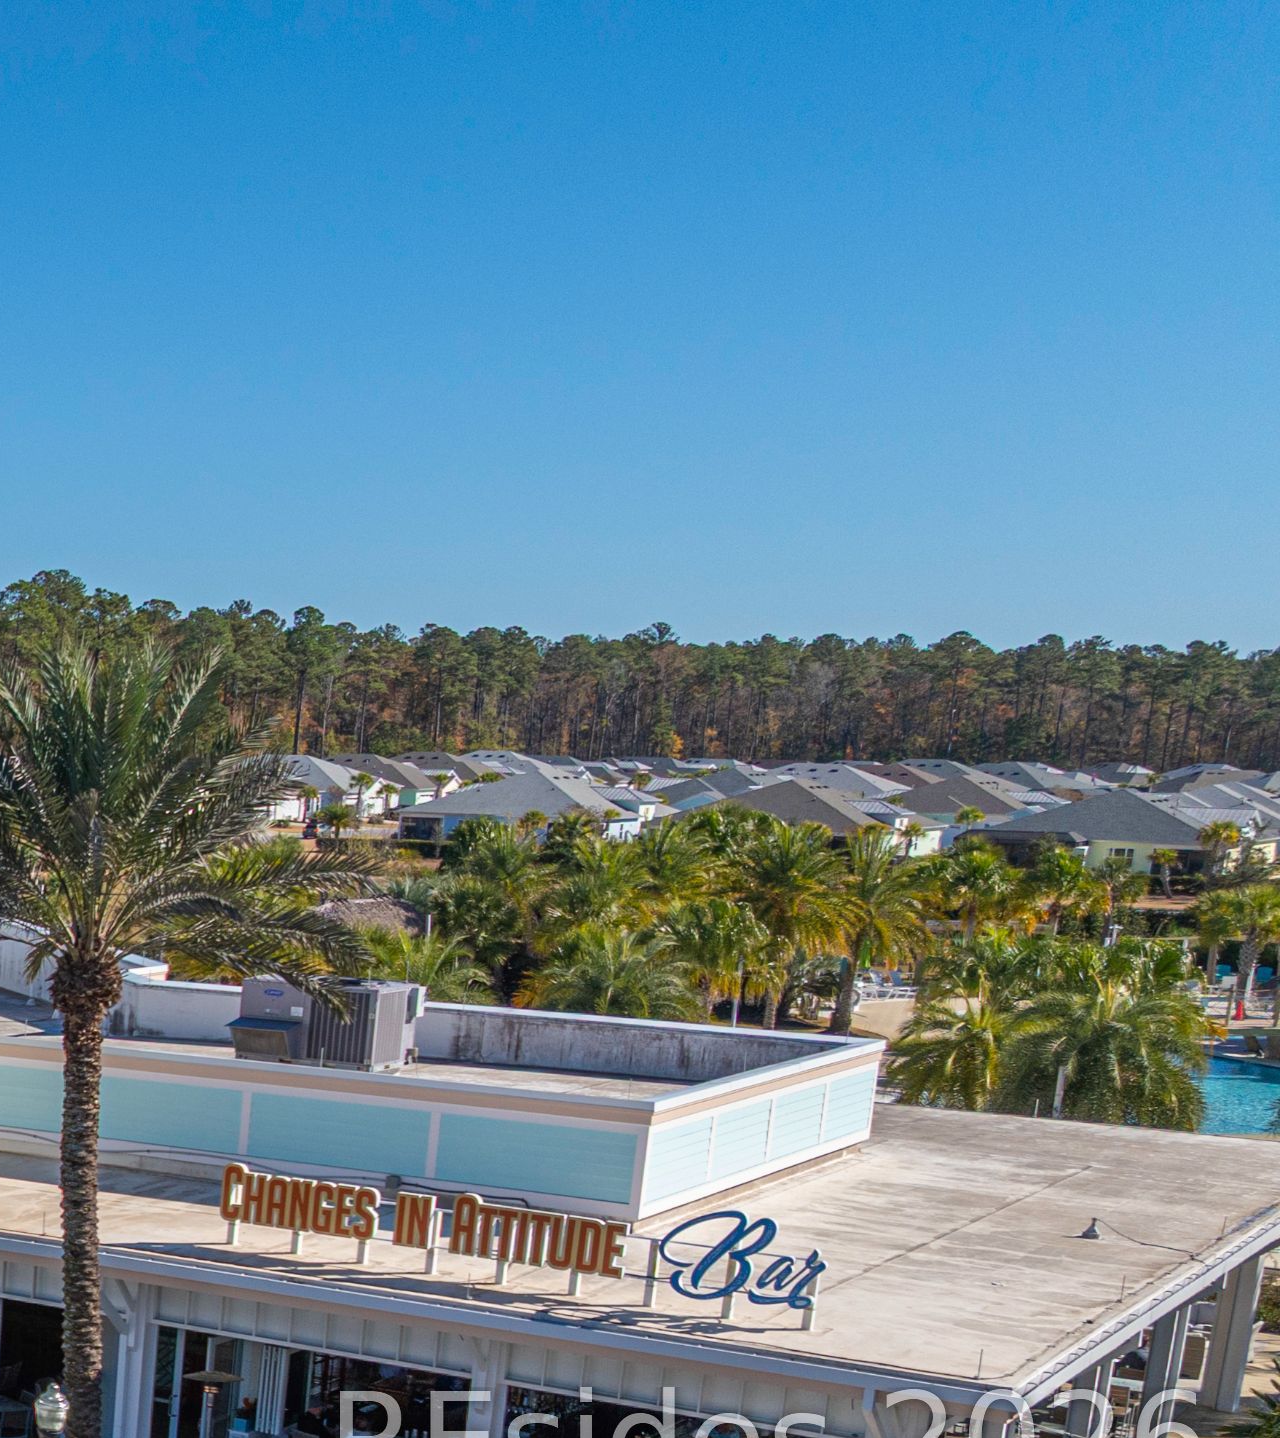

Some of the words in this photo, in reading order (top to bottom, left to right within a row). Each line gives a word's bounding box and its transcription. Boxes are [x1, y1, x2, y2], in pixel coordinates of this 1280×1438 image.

[220, 1163, 381, 1241] CHANGES
[392, 1191, 437, 1250] IN
[448, 1193, 631, 1280] ATTITUDE
[658, 1210, 829, 1310] Bar
